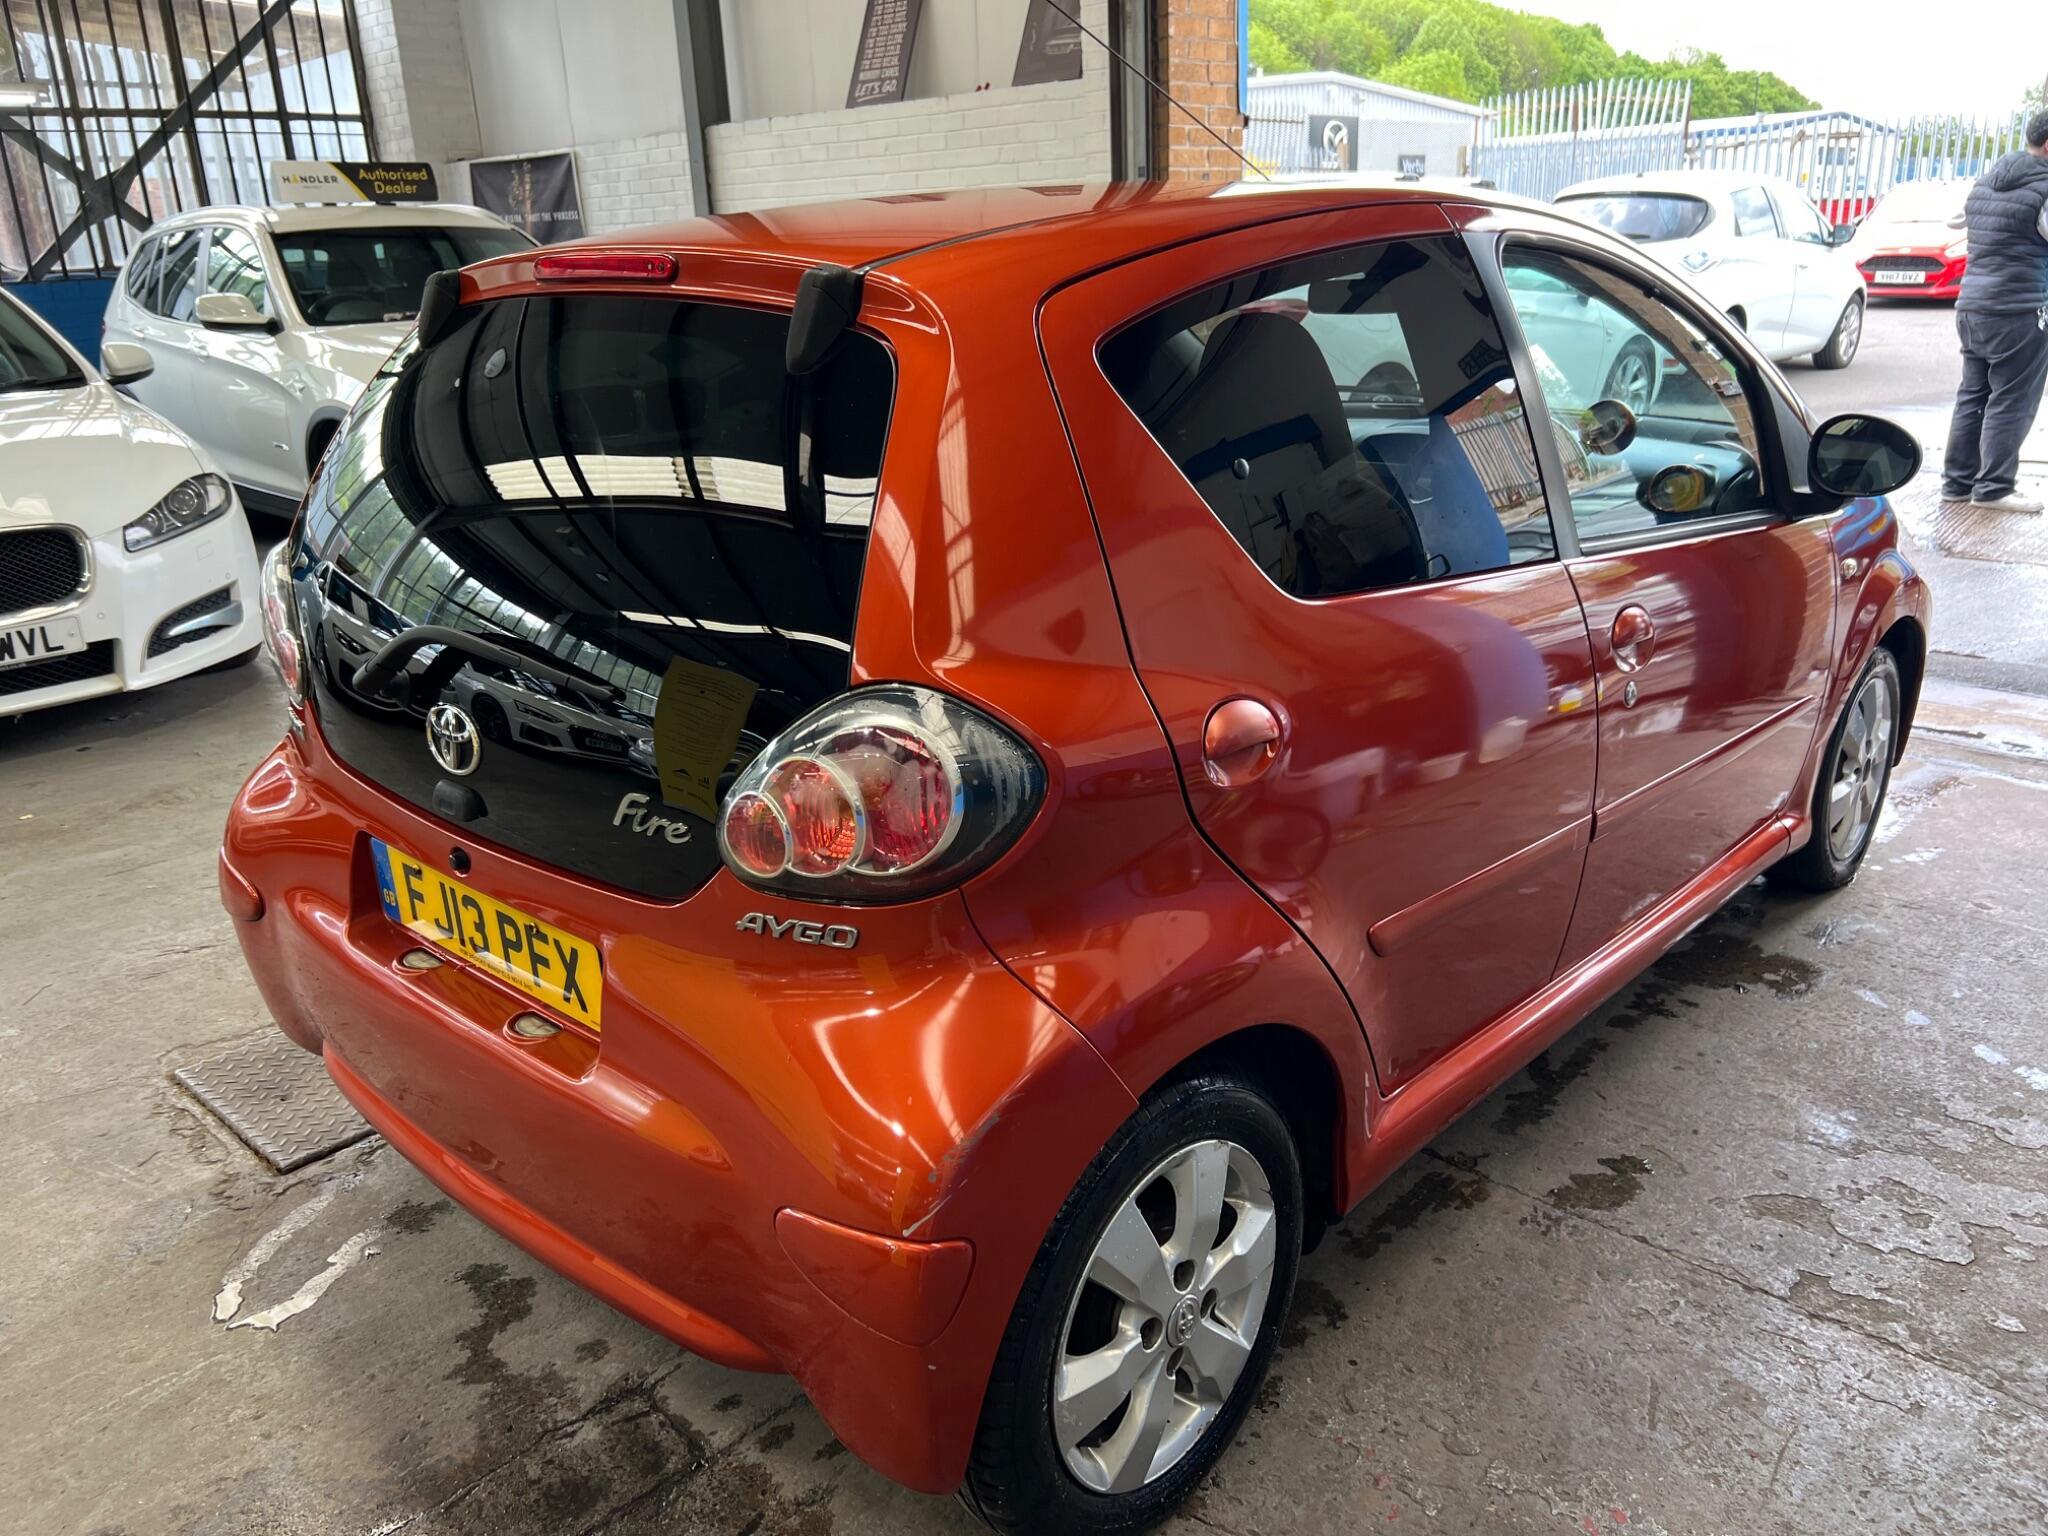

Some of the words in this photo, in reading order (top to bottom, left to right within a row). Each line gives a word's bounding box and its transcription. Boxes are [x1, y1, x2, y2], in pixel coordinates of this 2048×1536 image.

[282, 174, 339, 184] HANDLER
[359, 168, 428, 181] Authorised
[374, 182, 418, 194] Dealer
[612, 793, 691, 844] Fire
[383, 887, 396, 906] GB
[402, 862, 490, 953] FJ13
[496, 909, 588, 1013] PFX
[736, 912, 858, 949] AYGO
